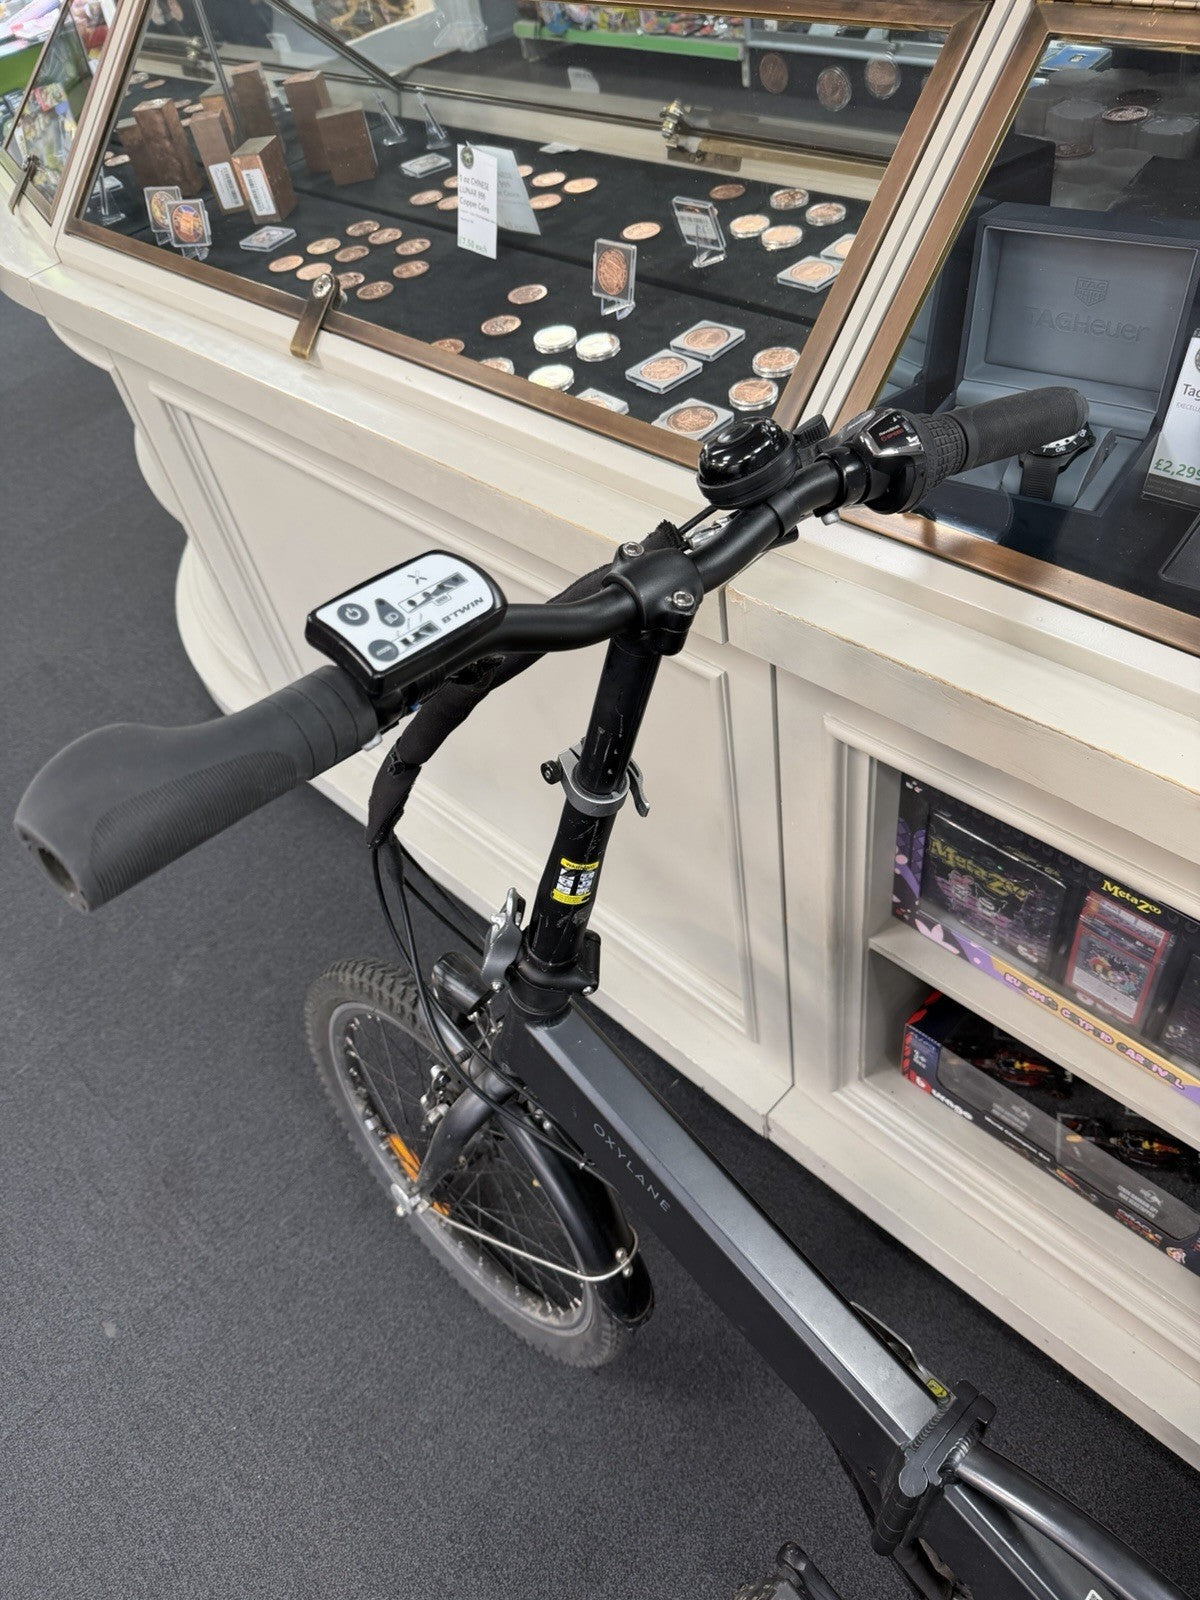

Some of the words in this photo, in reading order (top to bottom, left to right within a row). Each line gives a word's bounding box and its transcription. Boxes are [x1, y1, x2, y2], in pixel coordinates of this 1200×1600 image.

[459, 186, 477, 198] LUNAR
[459, 196, 478, 210] Copper
[479, 201, 490, 215] Coins
[1101, 880, 1162, 915] MetaZoo
[593, 1123, 671, 1213] OXYLANE
